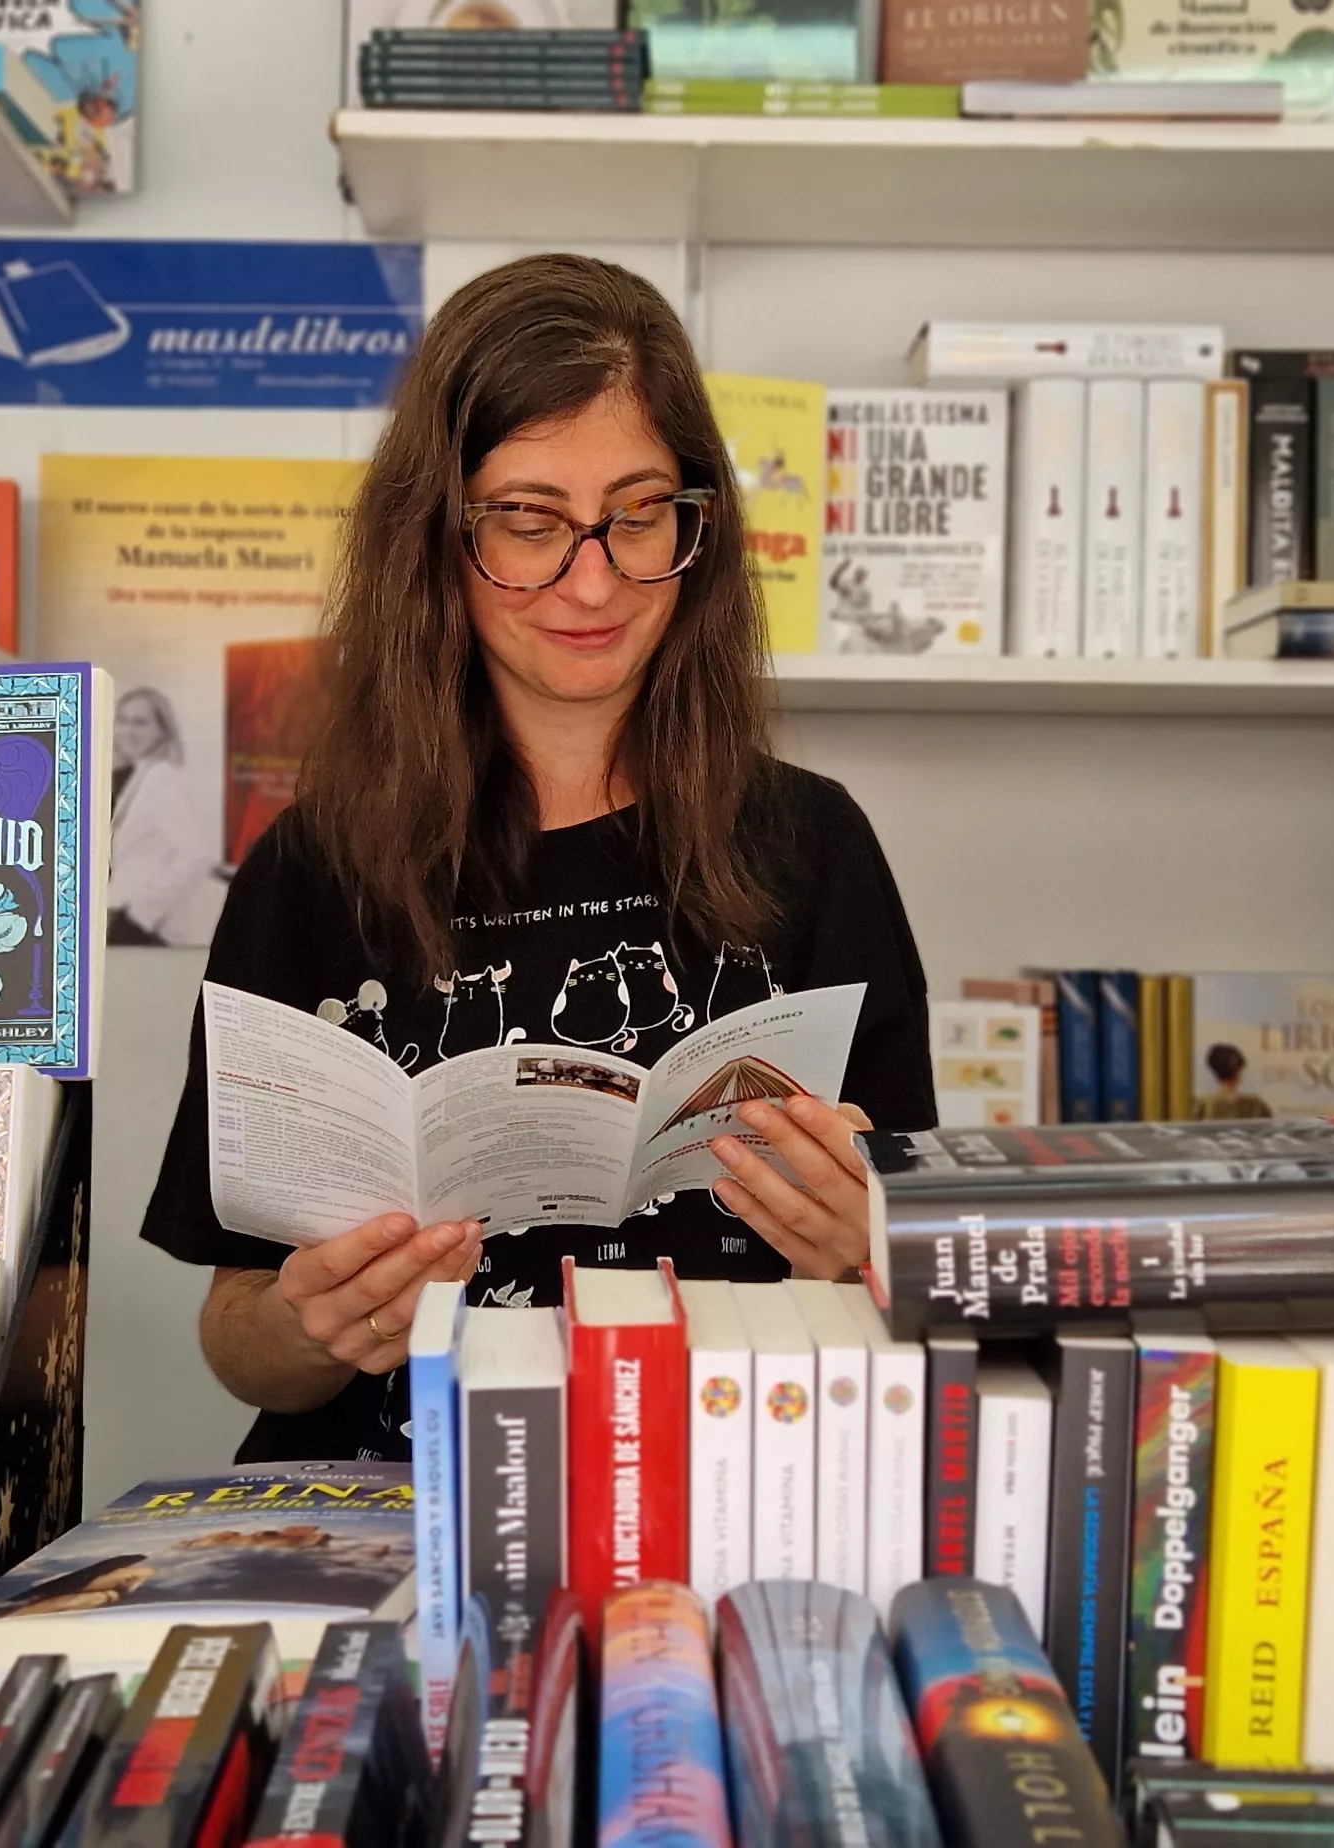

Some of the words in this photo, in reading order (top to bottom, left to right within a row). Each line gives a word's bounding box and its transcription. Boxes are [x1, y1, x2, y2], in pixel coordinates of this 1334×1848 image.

[150, 316, 409, 355] masdelibros
[866, 429, 928, 463] UNA
[866, 464, 988, 500] GRANDE
[865, 501, 952, 536] LIBRE
[450, 915, 477, 931] IT'S
[483, 907, 552, 928] WRITTEN
[559, 904, 574, 918] IN
[580, 900, 609, 916] THE
[615, 894, 659, 912] STARS
[597, 1242, 627, 1262] LIBRA
[929, 1236, 965, 1304] Juan
[959, 1214, 990, 1320] Manuel
[992, 1248, 1018, 1284] de
[1020, 1224, 1049, 1306] Prada
[608, 1357, 641, 1436] SÁNCHEZ
[495, 1413, 528, 1535] Maalouf
[613, 1439, 641, 1462] DE
[613, 1465, 641, 1562] DICTADURA
[713, 1457, 729, 1550] VITAMINA
[778, 1463, 796, 1549] VITAMINA
[1255, 1455, 1289, 1610] ESPAÑA
[613, 1565, 641, 1589] LA
[1248, 1639, 1277, 1738] REID
